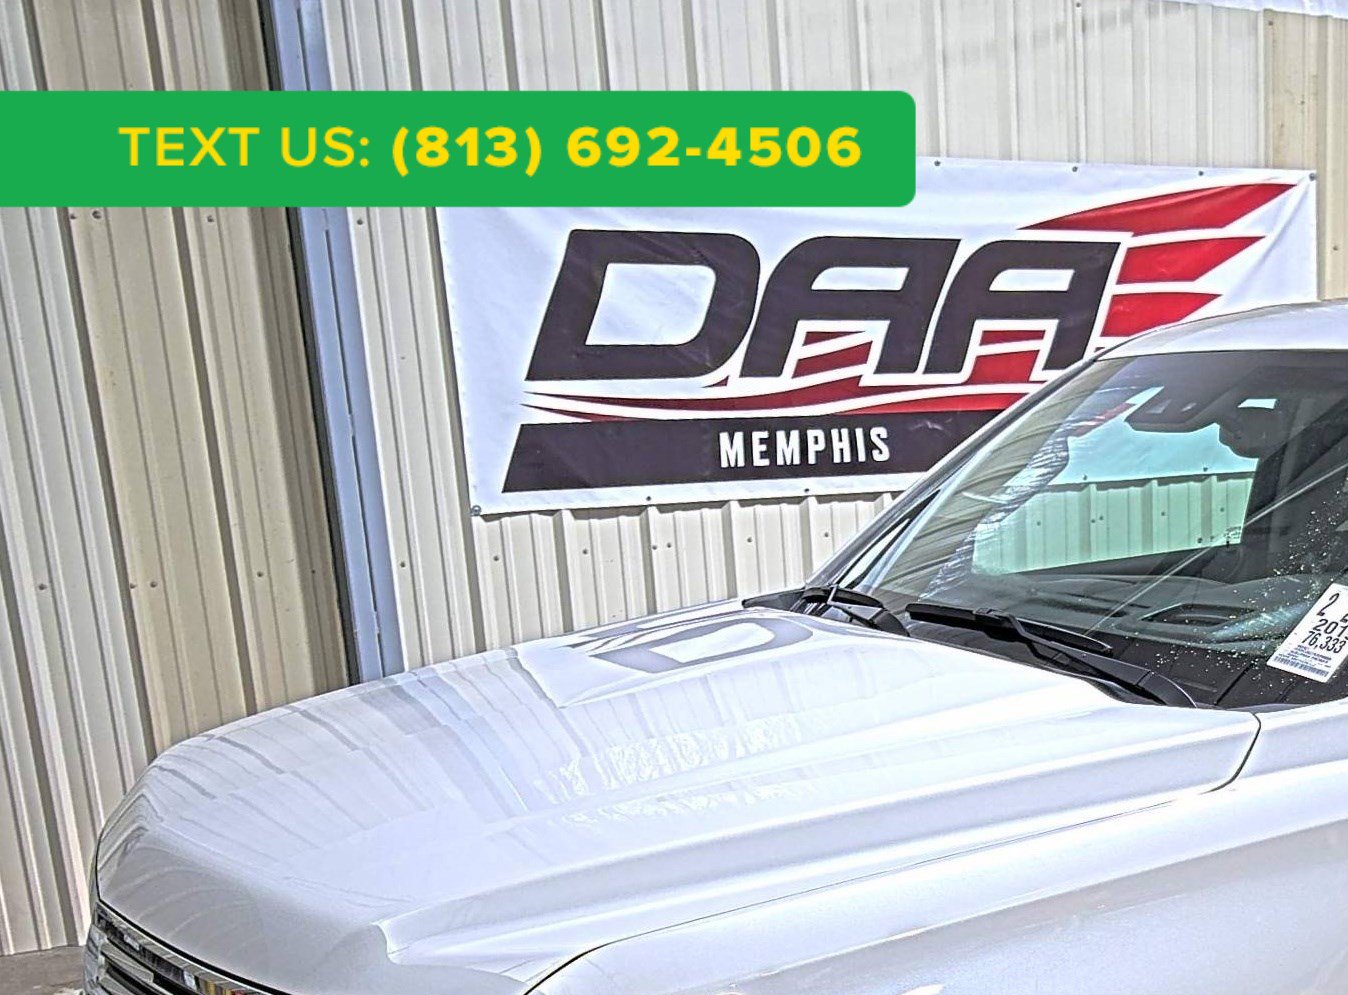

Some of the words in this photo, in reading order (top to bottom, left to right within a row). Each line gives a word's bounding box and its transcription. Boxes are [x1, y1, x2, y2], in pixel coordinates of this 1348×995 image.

[525, 228, 1121, 381] DAA
[719, 427, 891, 468] MEMPHIS
[1316, 592, 1340, 617] 2
[1301, 630, 1347, 654] 76,333
